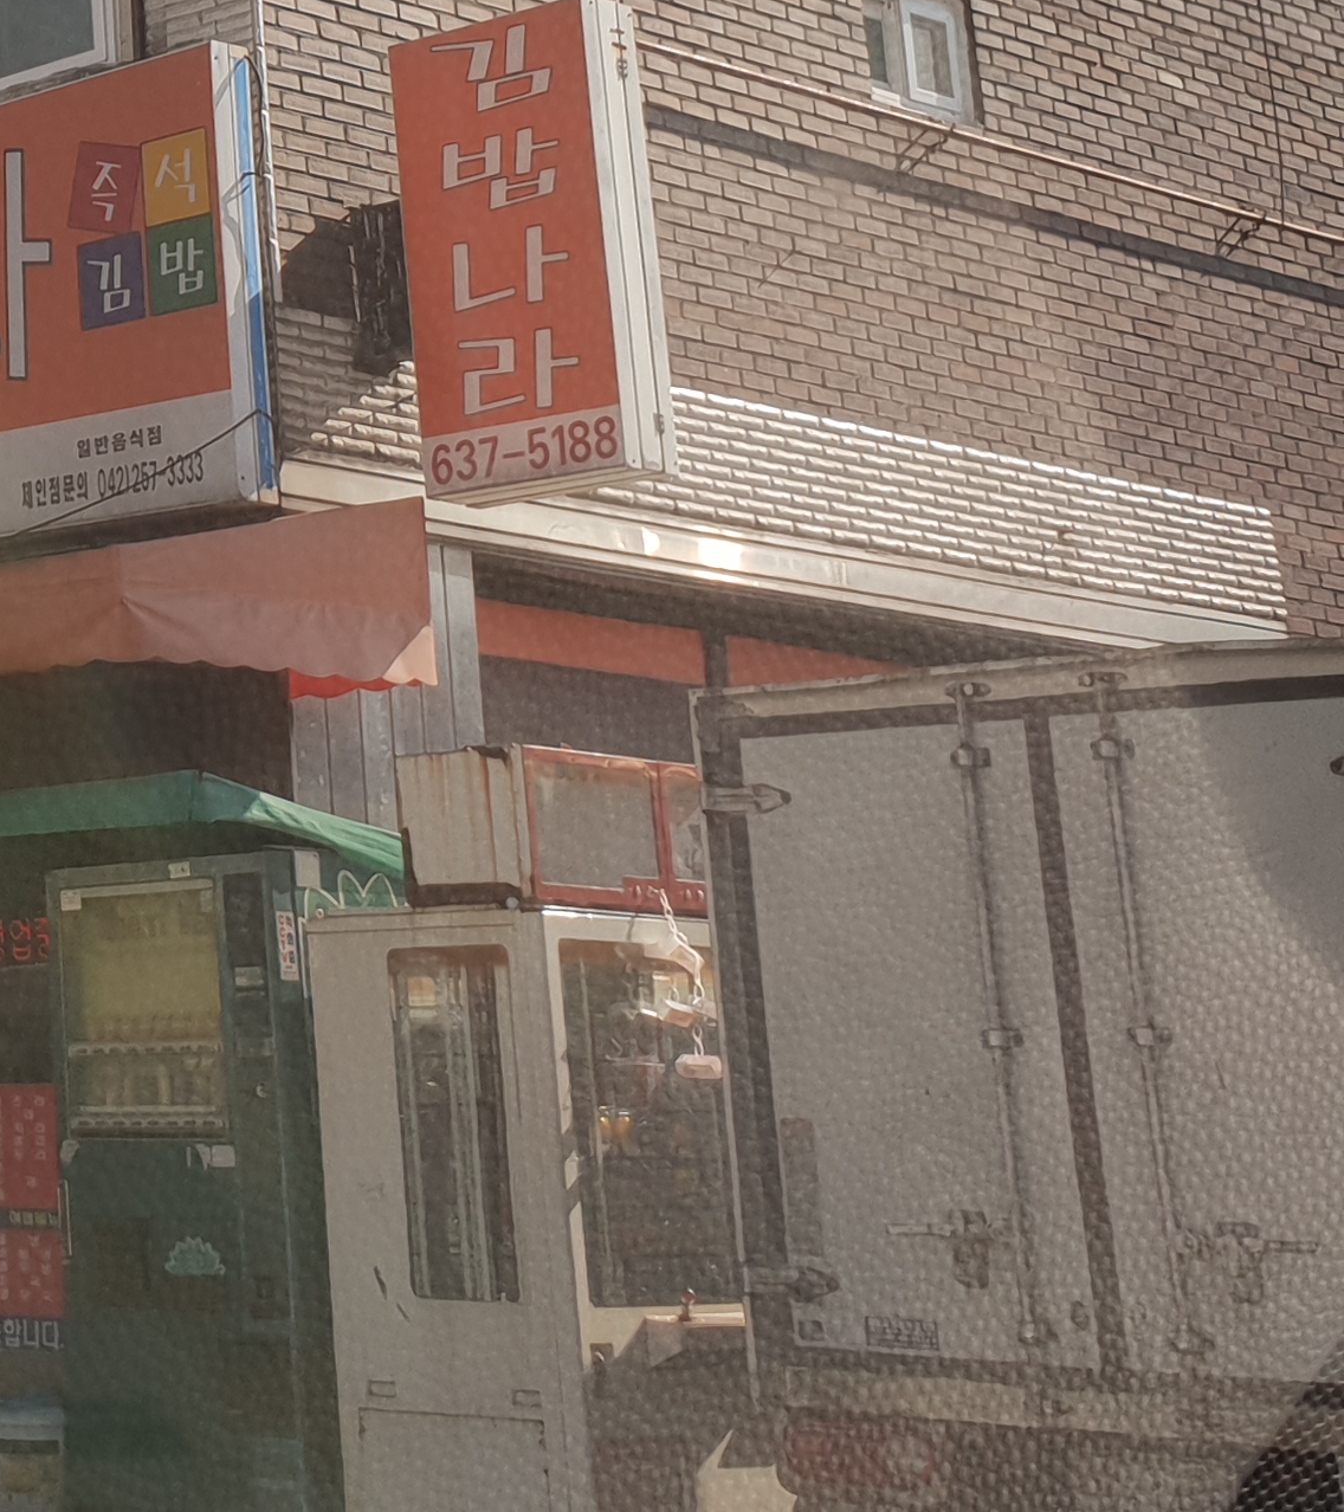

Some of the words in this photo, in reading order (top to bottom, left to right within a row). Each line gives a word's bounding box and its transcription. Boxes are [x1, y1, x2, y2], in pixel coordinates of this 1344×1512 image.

[90, 151, 198, 222] 즉석
[430, 24, 579, 416] 김밥나라
[88, 236, 207, 314] 김밥
[76, 425, 162, 458] 일반음식점
[431, 416, 618, 485] 637-5188
